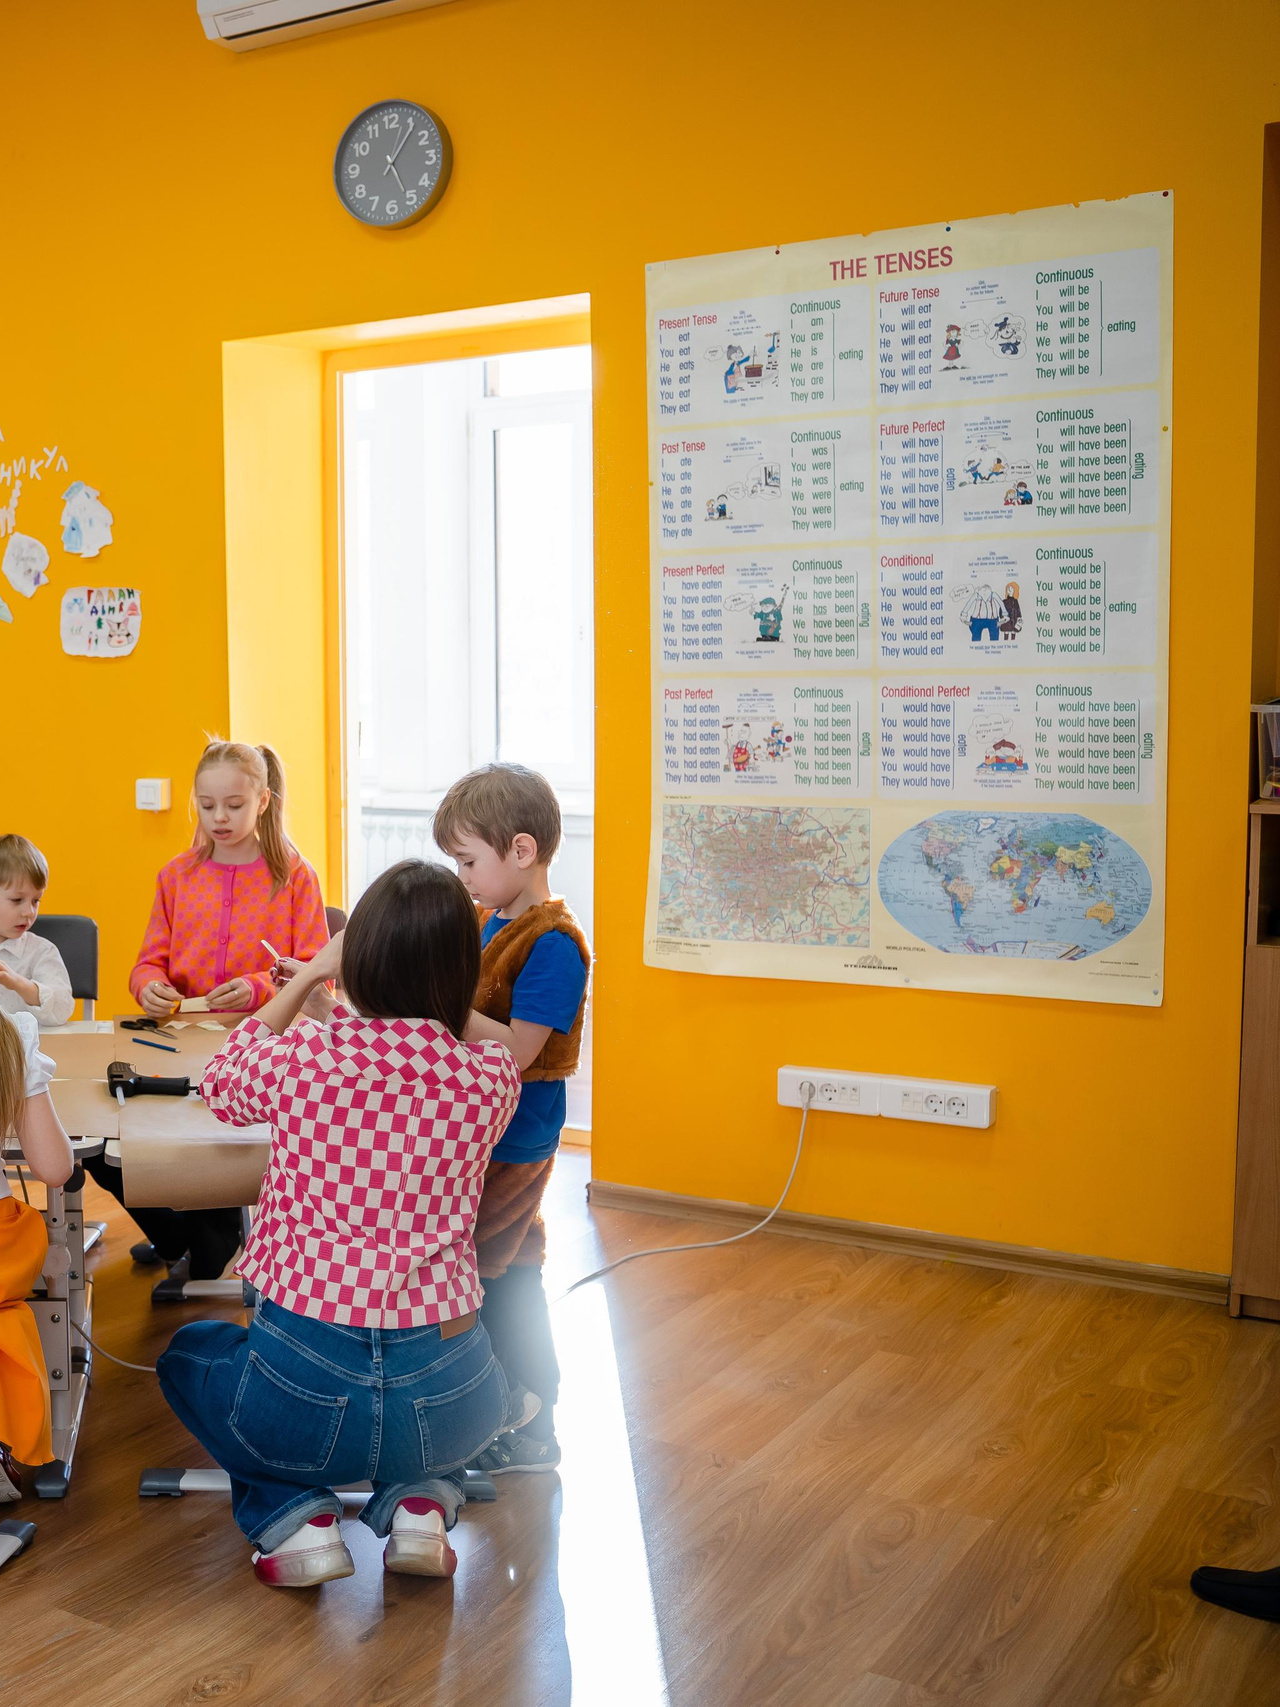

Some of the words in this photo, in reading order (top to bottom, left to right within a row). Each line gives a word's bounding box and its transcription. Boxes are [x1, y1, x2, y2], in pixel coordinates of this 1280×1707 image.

[382, 113, 399, 130] 12
[407, 116, 415, 131] 1
[367, 123, 379, 139] 11
[418, 130, 429, 145] 2
[353, 141, 370, 157] 10
[425, 149, 436, 165] 3
[348, 164, 360, 179] 9
[418, 173, 430, 187] 4
[354, 184, 366, 198] 8
[405, 190, 417, 205] 5
[369, 196, 380, 212] 7
[385, 200, 399, 215] 6
[829, 257, 867, 281] THE
[874, 245, 953, 275] TENSES
[1035, 267, 1094, 285] Continuous
[879, 291, 909, 303] Future
[911, 287, 940, 300] Tense
[790, 299, 841, 315] Continuous
[1035, 305, 1053, 316] You
[1059, 301, 1075, 313] will
[1078, 300, 1090, 311] be
[659, 316, 690, 330] Present
[692, 314, 717, 326] Tense
[810, 317, 824, 327] am
[879, 323, 895, 333] You
[901, 319, 915, 331] will
[918, 318, 932, 329] eat
[1107, 319, 1136, 333] eating
[1035, 336, 1050, 347] We
[1059, 332, 1075, 345] will
[1078, 332, 1089, 343] be
[790, 347, 801, 358] He
[811, 345, 818, 356] is
[838, 348, 863, 361] eating
[660, 362, 670, 372] He
[679, 360, 695, 370] eats
[879, 382, 899, 395] They
[901, 380, 915, 391] will
[918, 379, 932, 390] eat
[660, 404, 677, 415] They
[678, 402, 691, 413] eat
[1036, 408, 1094, 423] Continuous
[880, 424, 909, 436] Future
[912, 419, 945, 433] Perfect
[790, 429, 841, 443] Continuous
[901, 437, 916, 449] will
[918, 437, 939, 448] have
[661, 442, 679, 454] Past
[681, 441, 706, 452] Tense
[791, 462, 806, 472] You
[811, 461, 831, 471] were
[1134, 452, 1145, 480] eating
[661, 471, 675, 482] You
[680, 471, 692, 481] ate
[791, 476, 802, 487] He
[811, 476, 828, 485] was
[946, 467, 956, 492] eaten
[839, 480, 864, 492] eating
[1036, 490, 1053, 501] You
[1059, 488, 1075, 499] will
[1078, 487, 1100, 498] have
[1103, 486, 1126, 497] been
[880, 500, 896, 510] You
[901, 498, 916, 509] will
[918, 497, 939, 508] have
[662, 528, 679, 539] They
[680, 527, 692, 537] ate
[880, 553, 933, 568] Conditional
[1035, 547, 1093, 560] Continuous
[663, 565, 694, 577] Present
[696, 564, 725, 576] Perfect
[792, 559, 843, 572] Continuous
[813, 575, 832, 585] have
[834, 573, 855, 584] been
[881, 601, 892, 612] He
[902, 600, 927, 611] would
[930, 600, 943, 610] eat
[1036, 596, 1048, 607] He
[1058, 594, 1087, 606] would
[1089, 594, 1101, 605] be
[1108, 600, 1136, 614] eating
[663, 609, 673, 619] He
[681, 608, 695, 620] has
[701, 608, 722, 618] eaten
[860, 602, 870, 628] eating
[792, 619, 805, 629] We
[813, 618, 832, 628] have
[834, 618, 855, 628] been
[881, 645, 900, 658] They
[902, 645, 928, 656] would
[930, 645, 944, 655] eat
[1036, 642, 1056, 655] They
[1059, 641, 1086, 653] would
[1089, 641, 1101, 652] be
[663, 650, 680, 662] They
[682, 650, 700, 660] have
[701, 650, 723, 660] eaten
[664, 688, 682, 700] Past
[684, 688, 713, 700] Perfect
[793, 686, 844, 699] Continuous
[881, 685, 934, 698] Conditional
[937, 685, 970, 697] Perfect
[1035, 683, 1093, 696] Continuous
[683, 703, 697, 713] had
[699, 704, 720, 713] eaten
[793, 716, 808, 727] You
[813, 717, 829, 727] had
[831, 716, 851, 727] been
[881, 717, 897, 728] You
[902, 717, 928, 727] would
[930, 716, 951, 727] have
[861, 731, 871, 757] eating
[957, 733, 967, 757] eaten
[1142, 732, 1154, 760] eating
[881, 746, 895, 757] We
[903, 746, 928, 757] would
[930, 747, 951, 757] have
[1034, 747, 1049, 758] We
[1057, 747, 1085, 758] would
[1087, 747, 1110, 759] have
[1112, 747, 1135, 759] been
[665, 772, 682, 784] They
[683, 772, 698, 783] had
[699, 773, 720, 783] eaten
[794, 774, 812, 787] They
[814, 774, 829, 785] had
[831, 774, 851, 785] been
